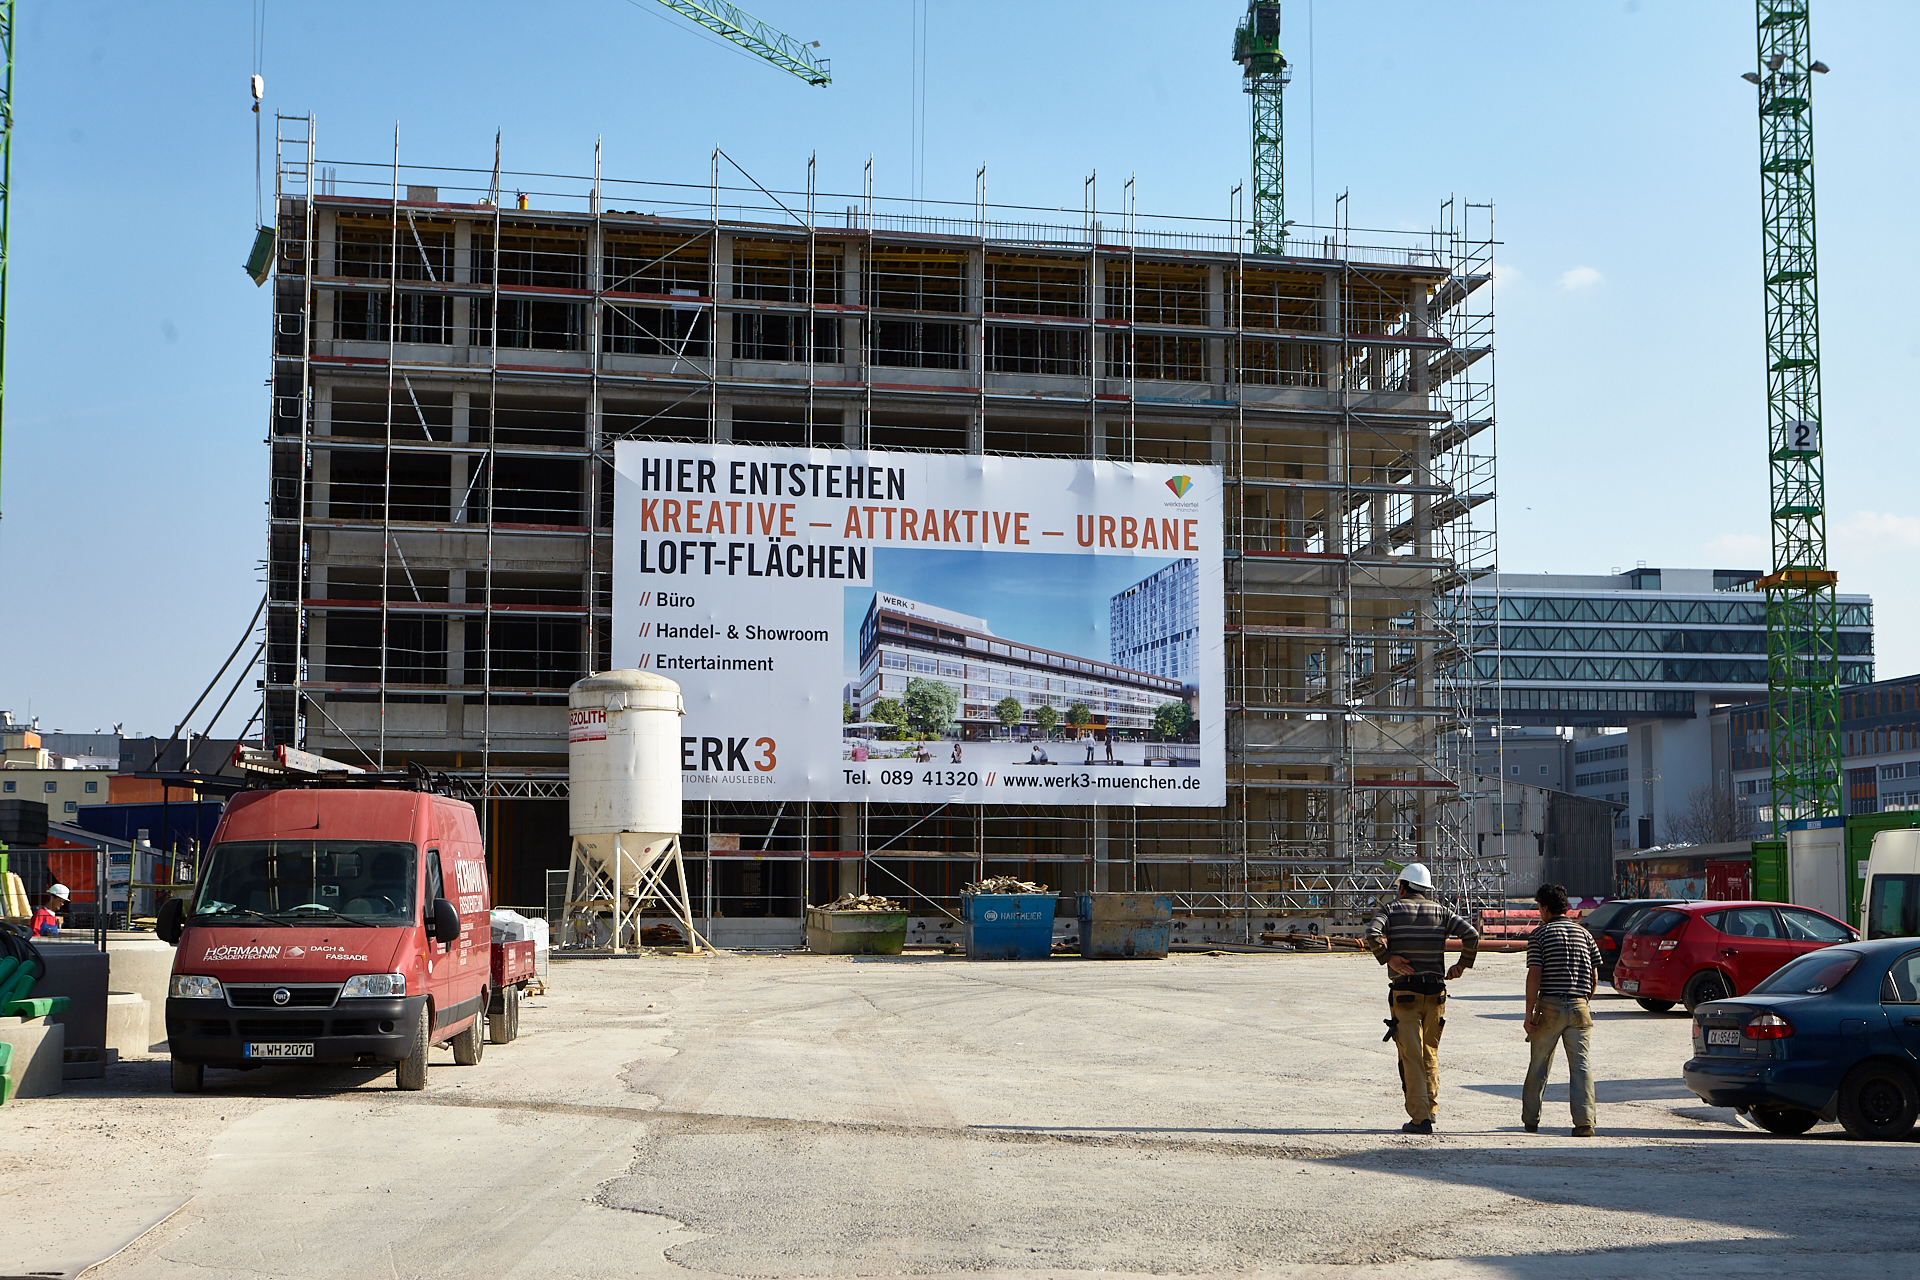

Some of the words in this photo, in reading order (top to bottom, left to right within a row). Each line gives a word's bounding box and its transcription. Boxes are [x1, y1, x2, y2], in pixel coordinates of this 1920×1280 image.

[1794, 424, 1810, 446] 2
[641, 457, 716, 493] HIER
[730, 461, 905, 500] ENTSTEHEN
[640, 498, 796, 536] KREATIVE
[843, 505, 1030, 545] ATTRAKTIVE
[1077, 514, 1199, 551] URBANE
[640, 537, 866, 579] LOFT-FLÄCHEN
[656, 592, 695, 608] Büro
[883, 595, 908, 609] WERK
[656, 623, 721, 639] Handel-
[727, 624, 740, 639] &
[745, 625, 829, 641] Showroom
[656, 654, 774, 671] Entertainment
[569, 710, 607, 726] RZOLITH
[681, 736, 777, 772] ERK3
[681, 774, 718, 784] TIONEN
[722, 775, 776, 784] AUSLEBEN.
[843, 769, 871, 785] Tel.
[880, 770, 914, 786] 089
[922, 771, 979, 787] 41320
[1003, 774, 1200, 790] www.werk3-muenchen.de
[1000, 911, 1043, 920] HARTMEIER
[205, 944, 281, 956] HÖRMANN
[284, 1044, 313, 1056] 2070
